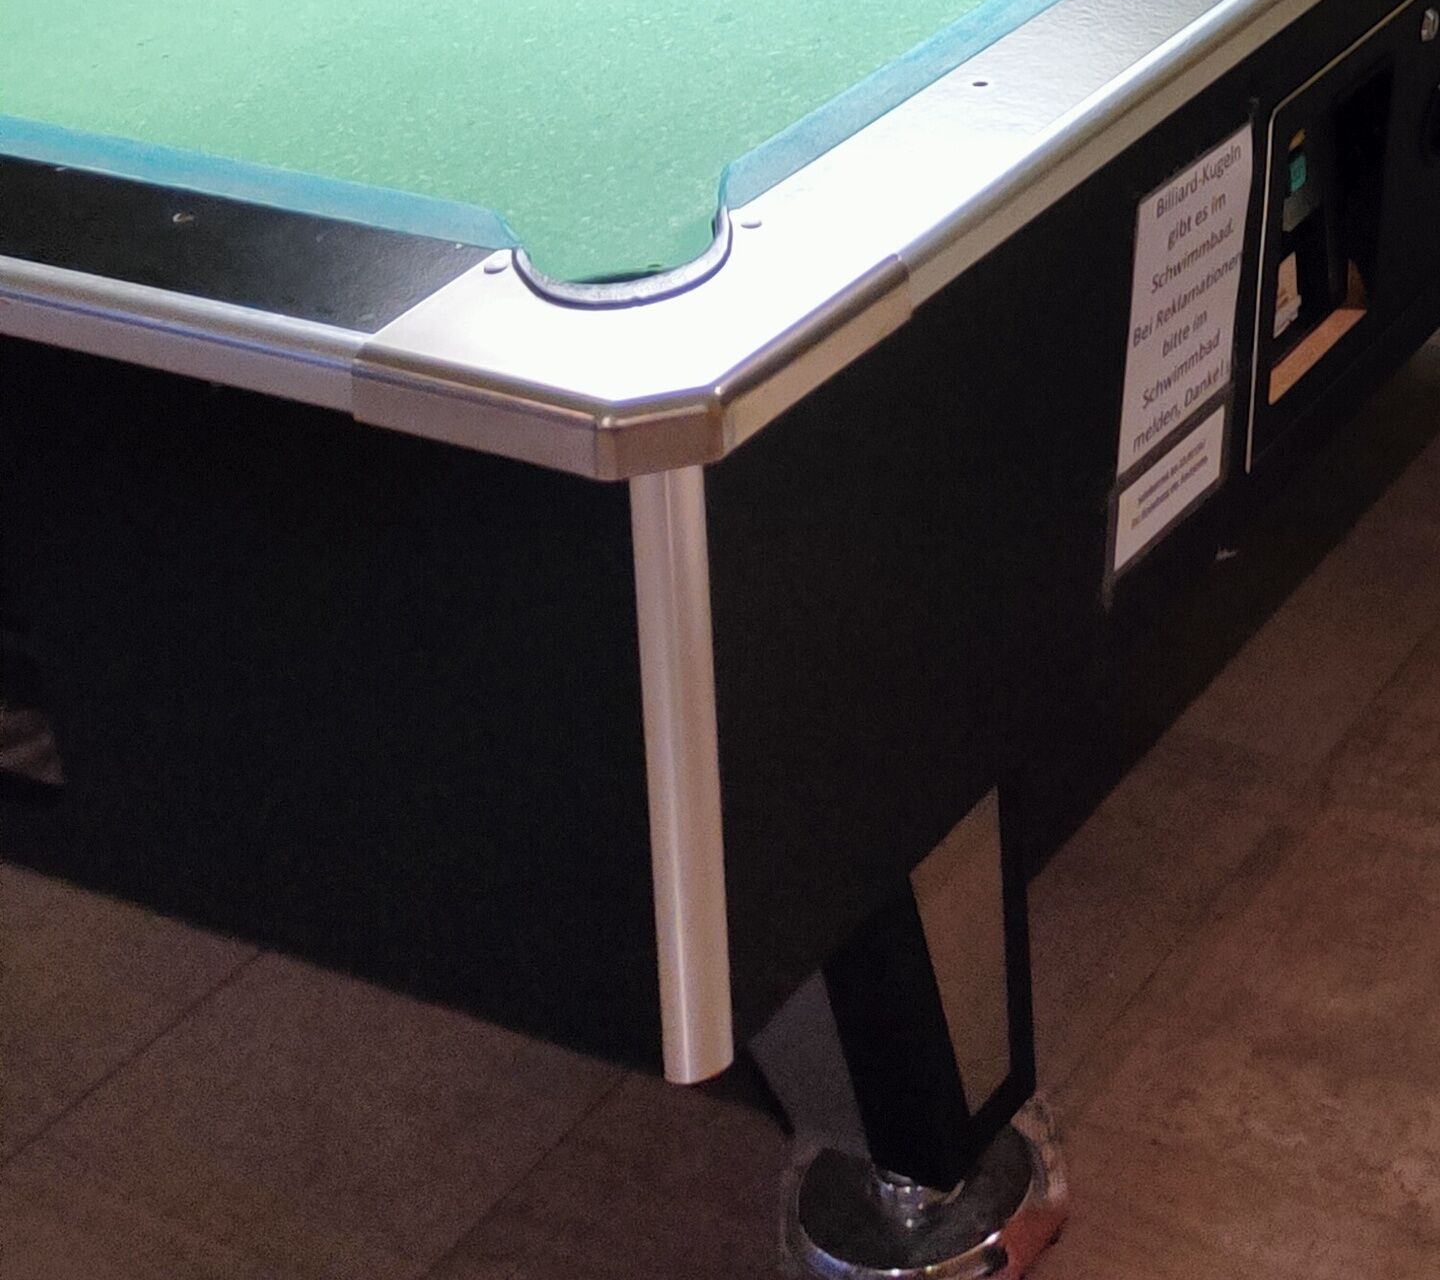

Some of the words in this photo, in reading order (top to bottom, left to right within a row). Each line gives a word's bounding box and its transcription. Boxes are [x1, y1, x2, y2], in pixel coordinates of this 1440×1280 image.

[1157, 145, 1241, 218] Billiard-Kugeln
[1152, 217, 1234, 293] Schwimmbad.
[1168, 216, 1191, 251] gibt
[1195, 205, 1209, 226] es
[1211, 193, 1226, 215] im
[1133, 321, 1152, 348] Bei
[1142, 328, 1221, 409] Schwimmbad
[1162, 324, 1190, 358] bitte
[1193, 309, 1207, 333] im
[1133, 404, 1181, 452] melden,
[1184, 358, 1224, 408] Danke!
